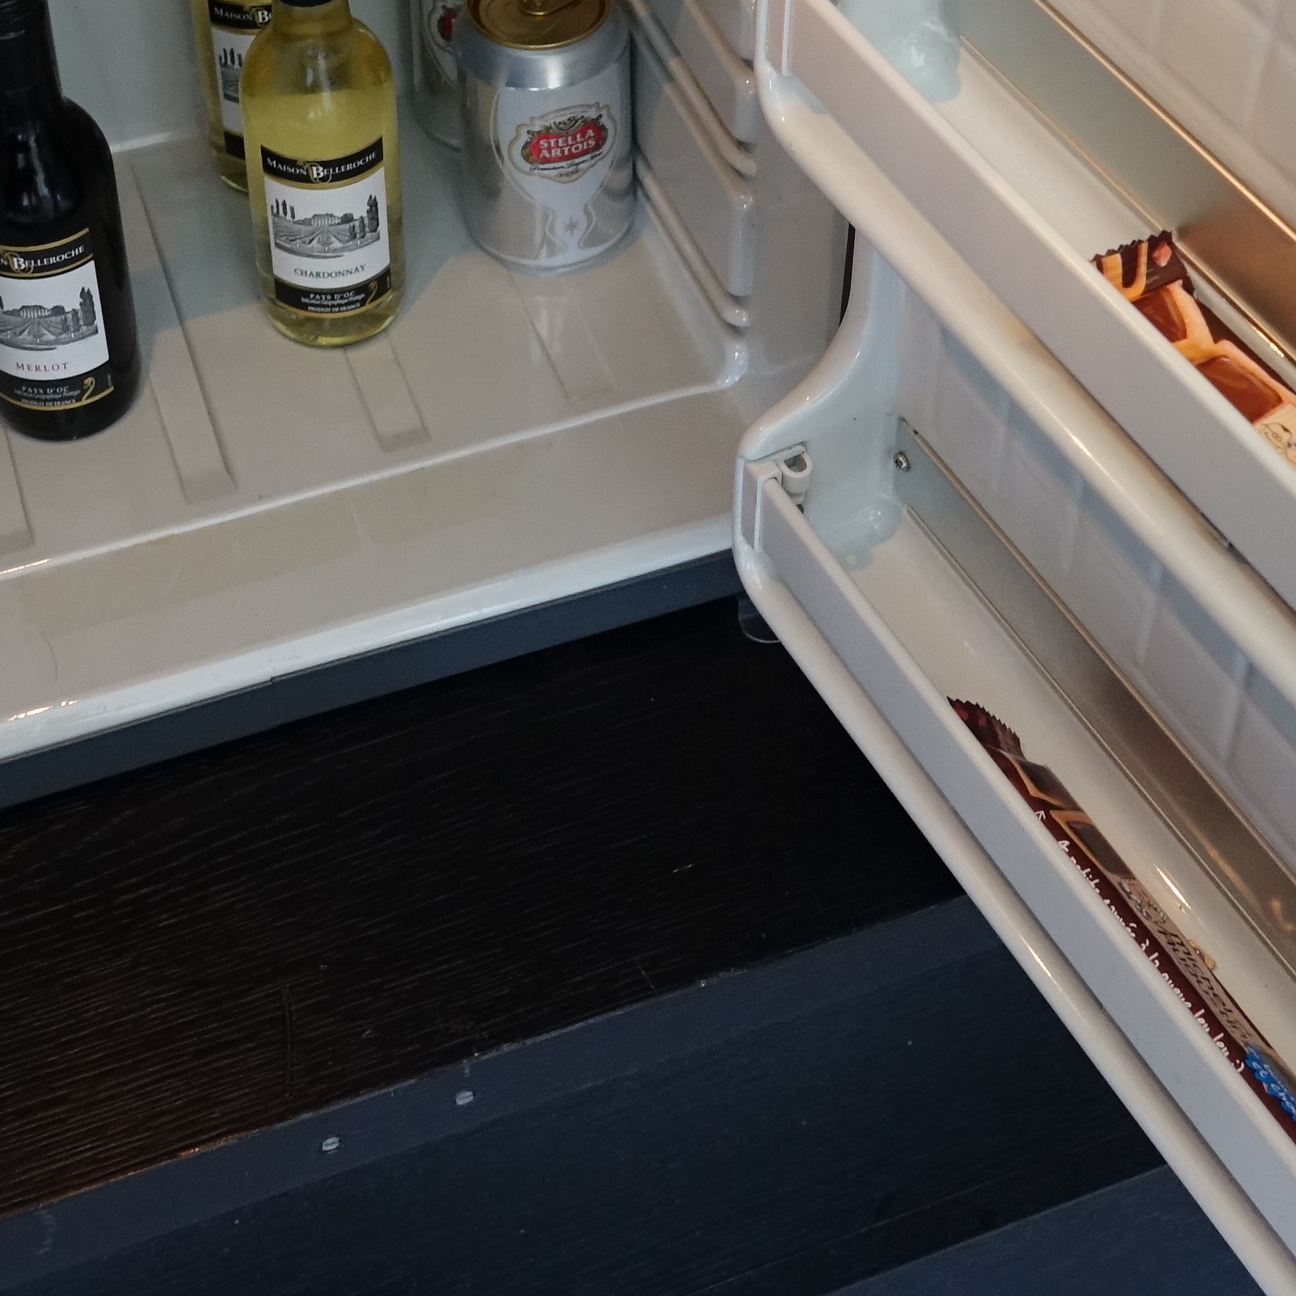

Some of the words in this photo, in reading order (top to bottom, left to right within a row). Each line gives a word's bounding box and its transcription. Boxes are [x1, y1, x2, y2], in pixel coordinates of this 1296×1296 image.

[214, 6, 253, 21] MAISON
[539, 128, 595, 148] STELLA
[539, 138, 596, 159] ARTOIS
[266, 157, 308, 176] MAISON
[312, 150, 377, 178] BELLEROCHE
[12, 244, 85, 270] BELLEROCHE
[294, 263, 366, 279] CHARDONNAY
[309, 293, 332, 302] PAYS
[16, 361, 69, 372] MERLOT
[22, 386, 44, 394] PAYS
